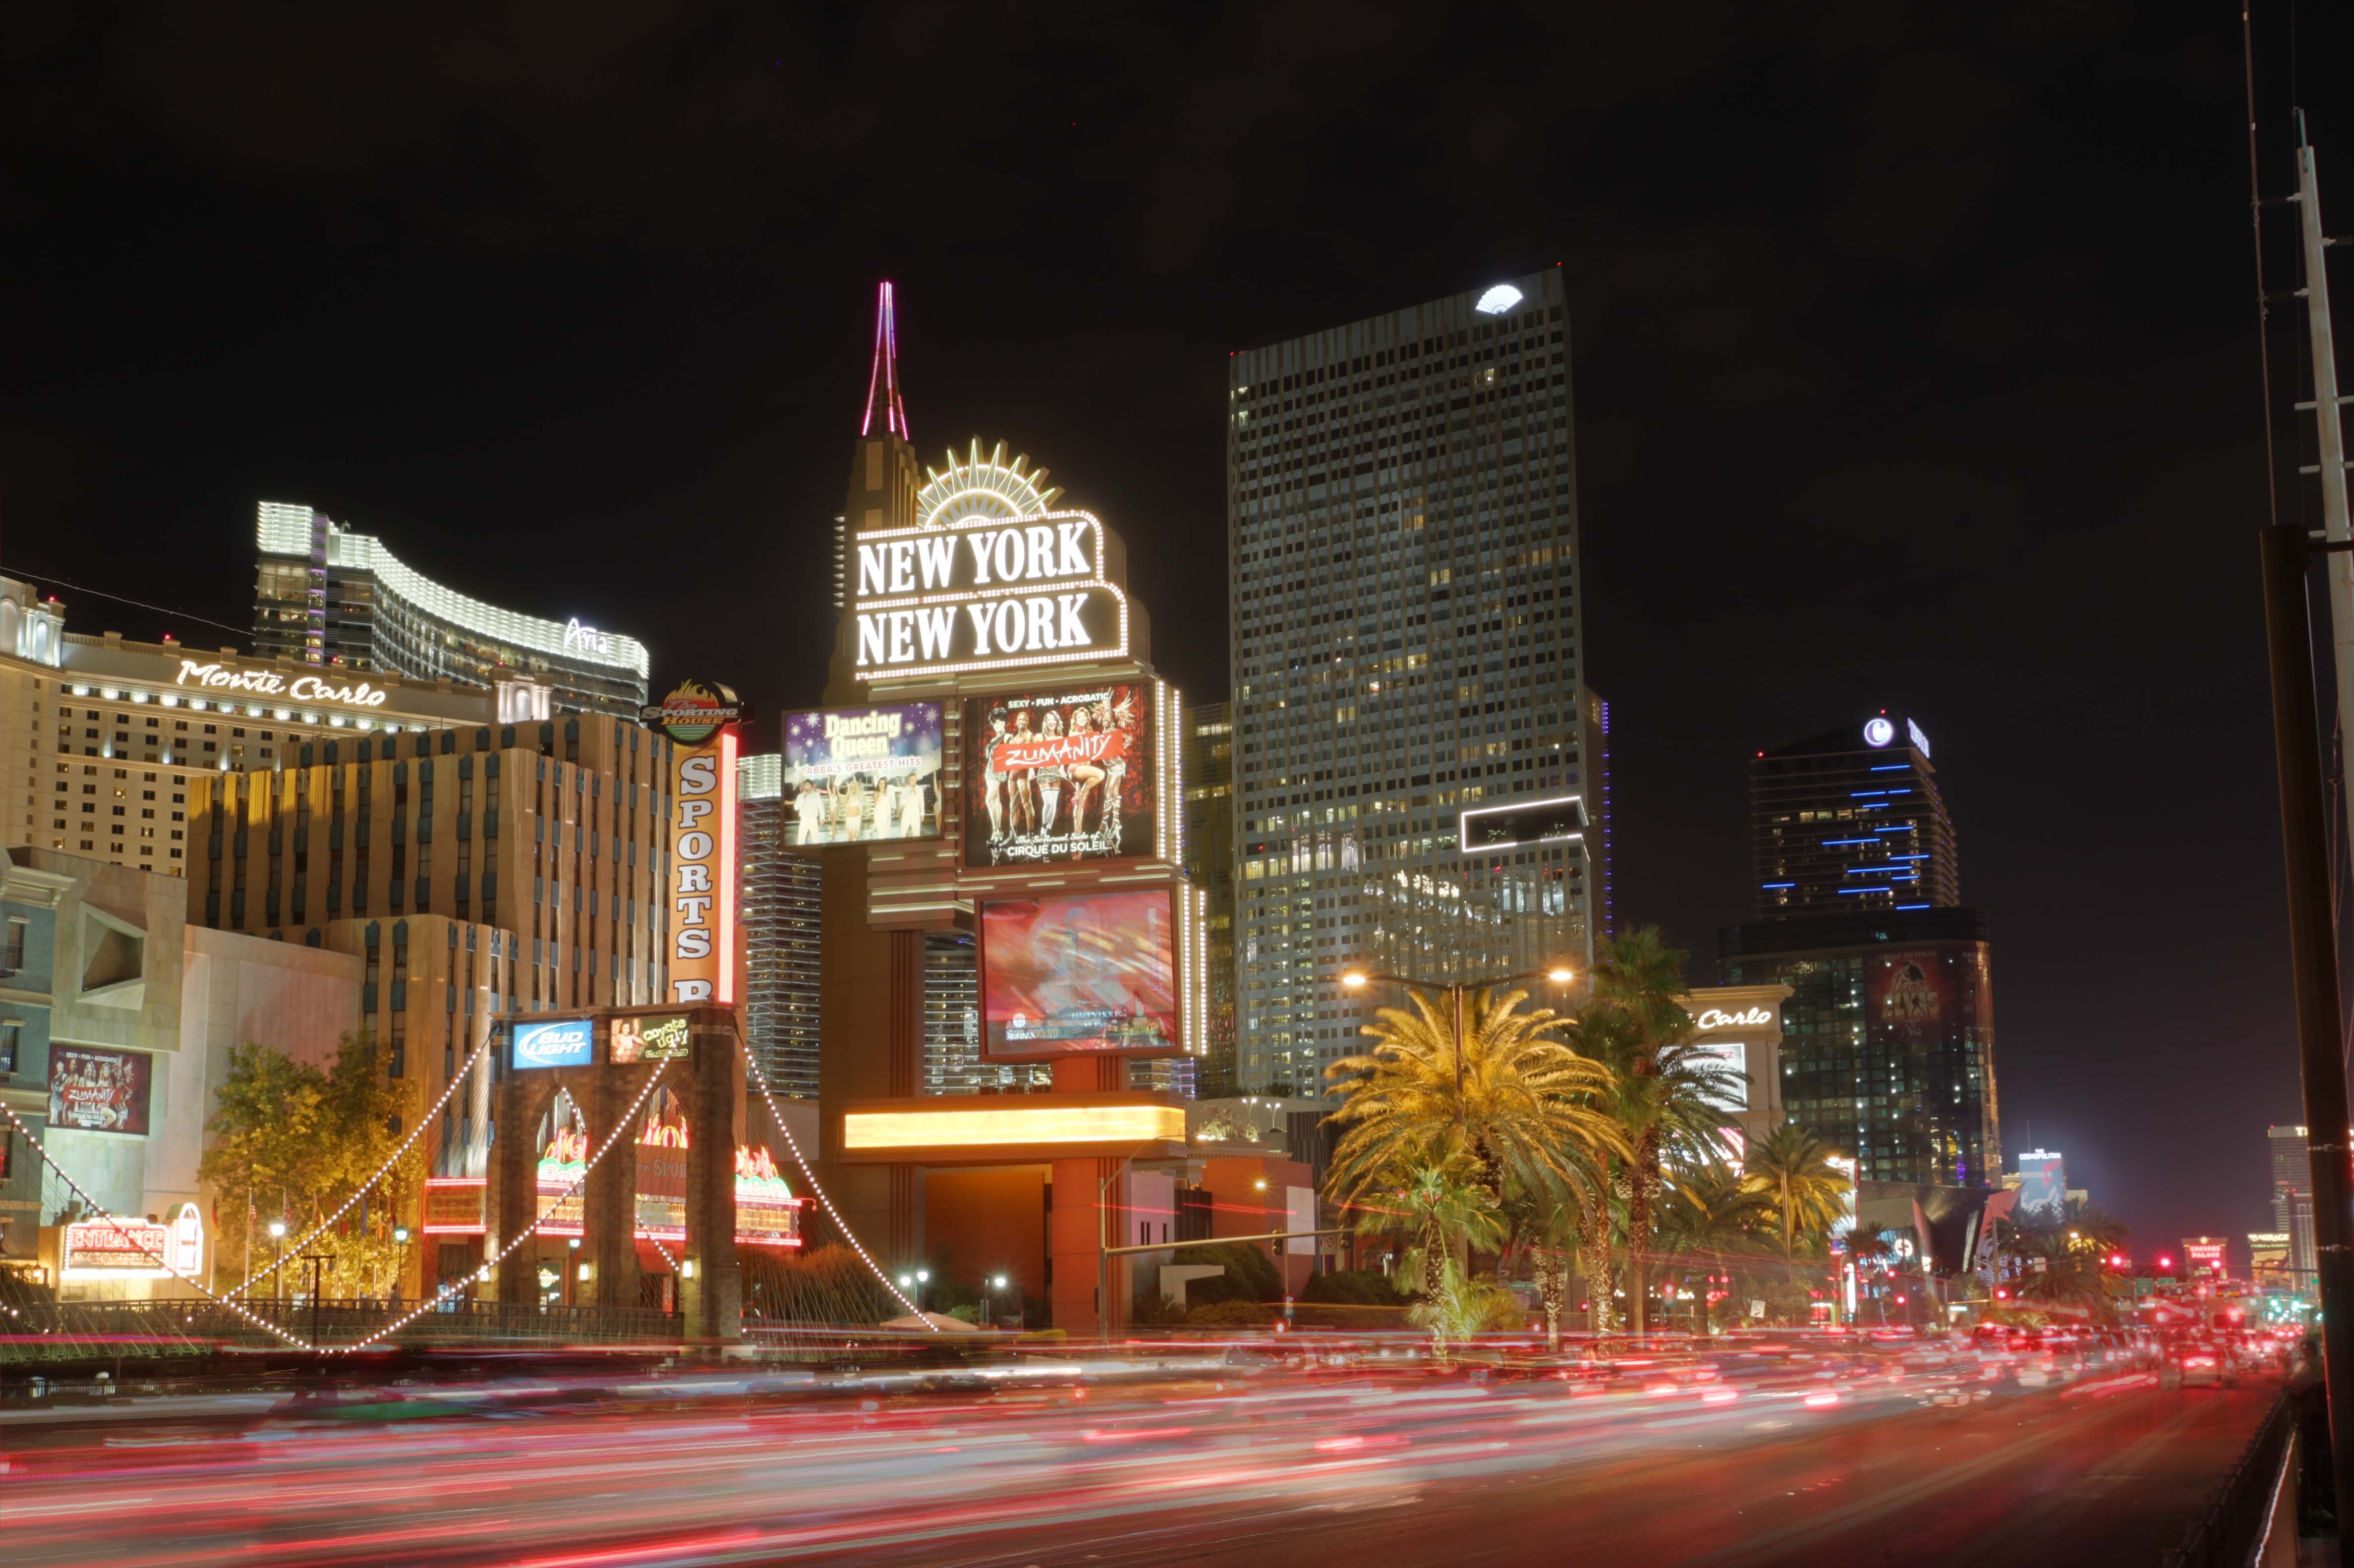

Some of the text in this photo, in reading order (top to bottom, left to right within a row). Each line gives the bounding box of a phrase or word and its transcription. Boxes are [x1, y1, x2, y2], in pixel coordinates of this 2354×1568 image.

[857, 521, 1091, 595] NEW YORK
[564, 618, 607, 654] Aria
[857, 593, 1091, 666] NEW YORK
[176, 660, 386, 706] Monte Carlo
[1008, 693, 1110, 708] SEXY FUN ACROBATIC
[641, 707, 738, 719] SPORTING
[661, 717, 725, 725] HOUSE
[825, 710, 902, 738] Dancing
[831, 735, 889, 761] Queen
[1005, 735, 1111, 766] ZUMANITY
[806, 757, 920, 774] ABBA'S GREATEST HITS
[1016, 836, 1031, 844] The
[1071, 832, 1089, 840] Side
[1091, 831, 1100, 842] of
[677, 755, 717, 959] SPORTS
[1007, 841, 1109, 858] CIRQUE DU SOLEIL
[1698, 1007, 1772, 1029] Carlo
[537, 1031, 583, 1045] BUD
[643, 1019, 687, 1041] coyote
[528, 1042, 587, 1056] LIGHT
[68, 1088, 115, 1103] ZUMANITY
